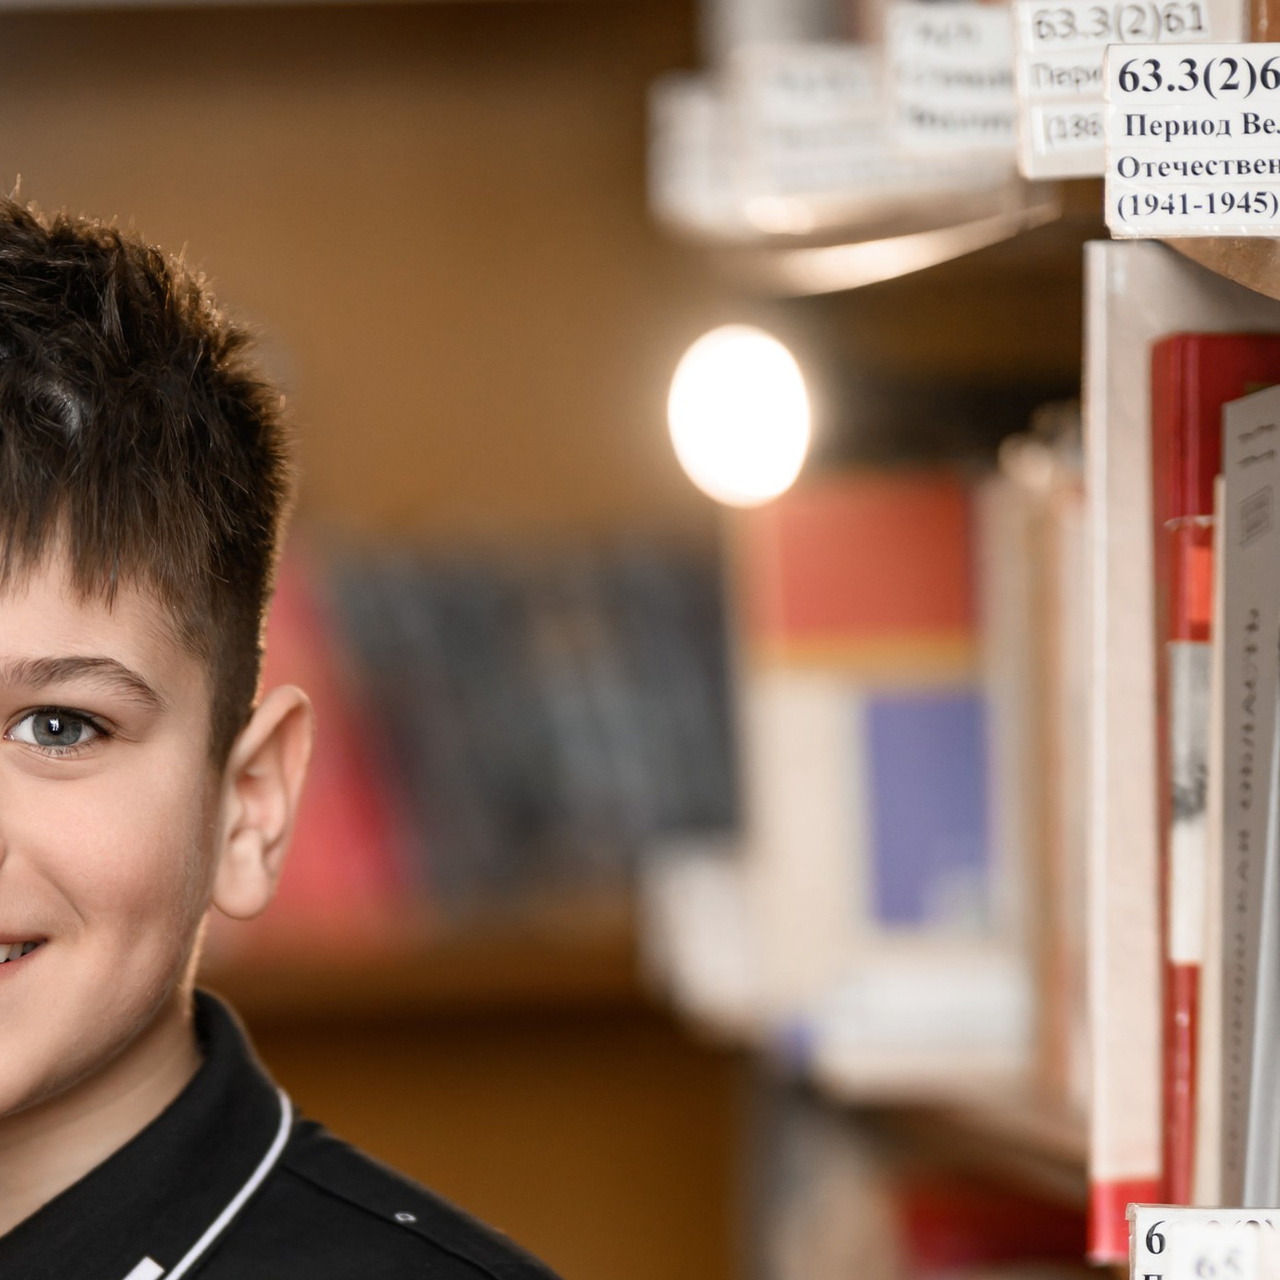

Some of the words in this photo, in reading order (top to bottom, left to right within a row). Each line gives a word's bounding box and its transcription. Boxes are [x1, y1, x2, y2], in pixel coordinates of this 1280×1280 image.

[1118, 56, 1280, 99] 63.3(2)6
[1125, 113, 1232, 142] Период
[1241, 112, 1280, 135] Ве
[1117, 156, 1280, 178] Отечествен
[1117, 190, 1279, 222] (1941-1945)
